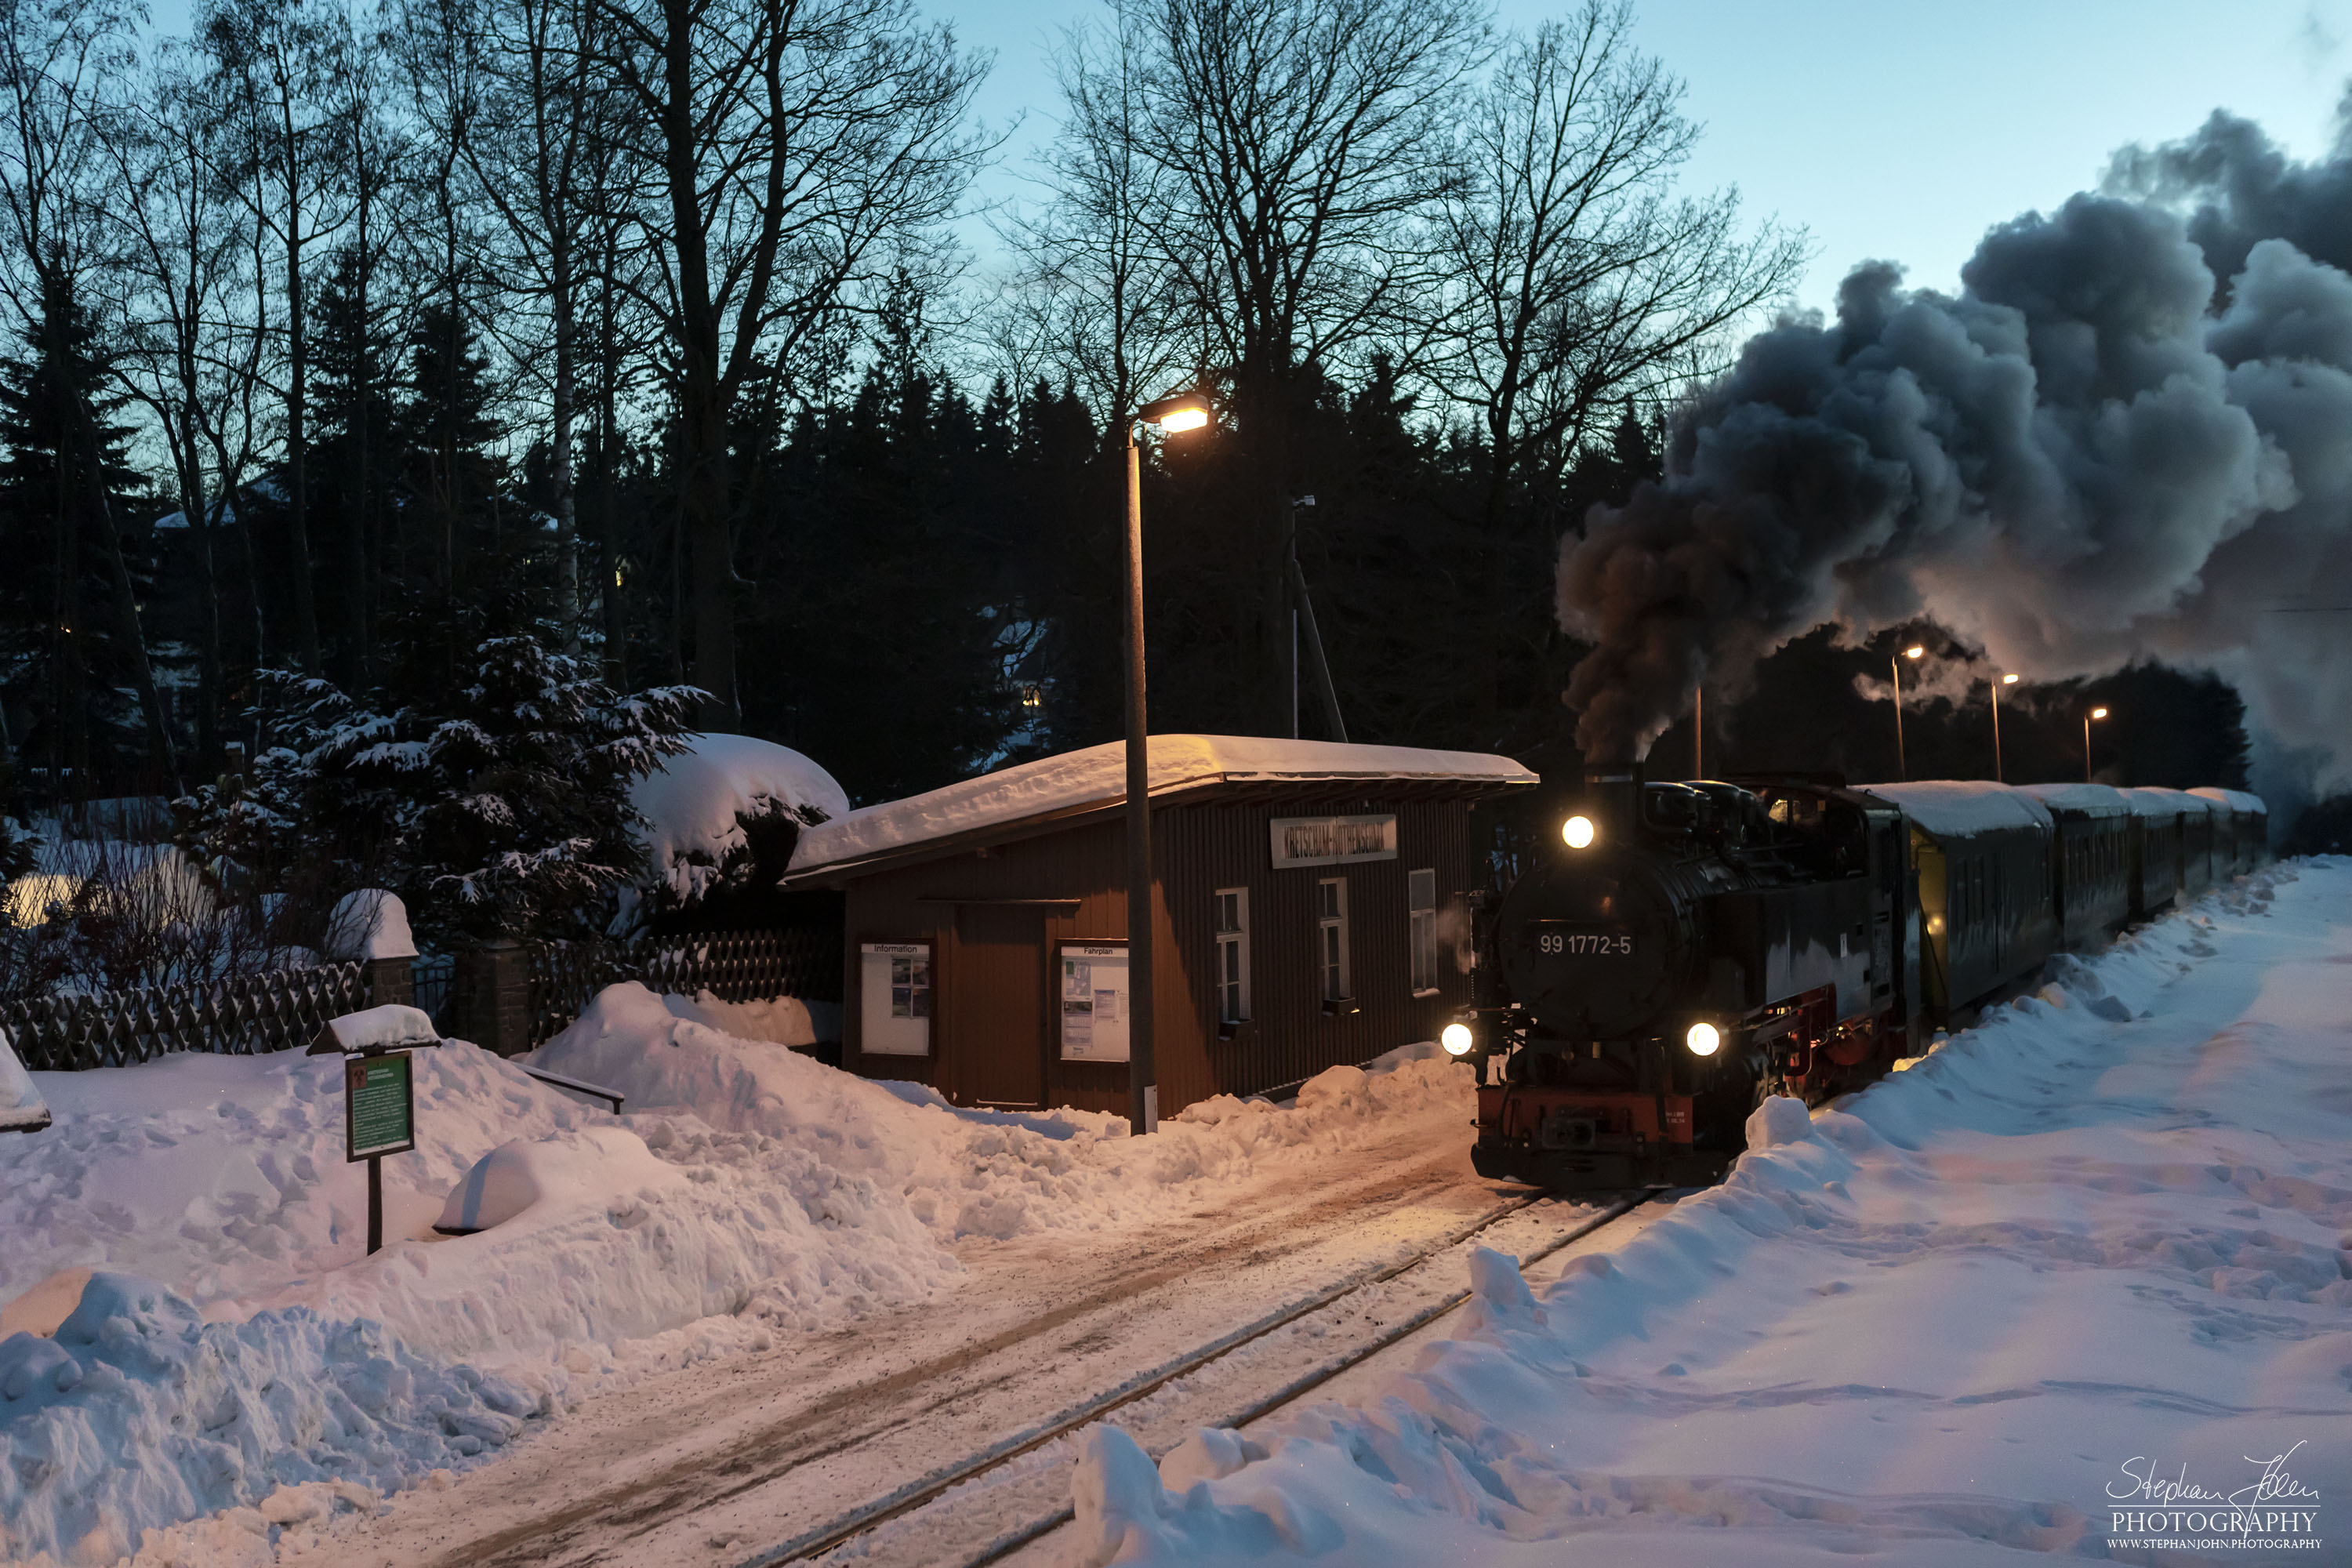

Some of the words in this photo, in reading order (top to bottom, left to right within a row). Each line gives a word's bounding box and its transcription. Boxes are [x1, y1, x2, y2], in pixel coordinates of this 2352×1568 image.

[874, 945, 917, 953] Information
[1541, 935, 1563, 953] 99
[1568, 936, 1632, 954] 1772-5
[1084, 947, 1113, 956] Fahrplan
